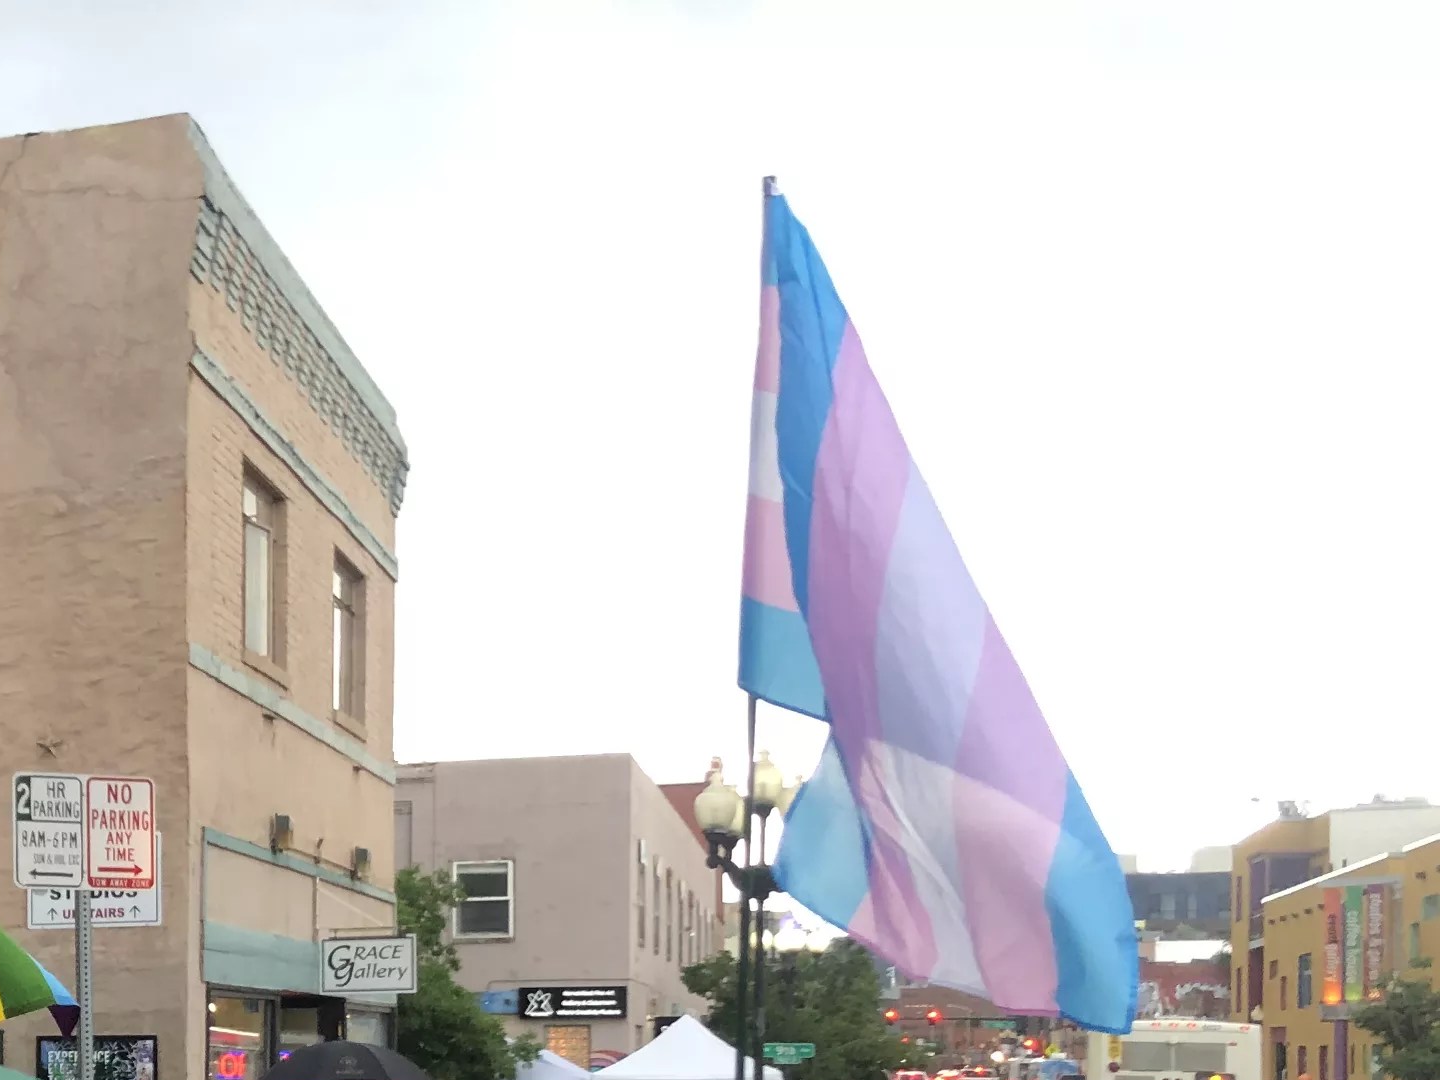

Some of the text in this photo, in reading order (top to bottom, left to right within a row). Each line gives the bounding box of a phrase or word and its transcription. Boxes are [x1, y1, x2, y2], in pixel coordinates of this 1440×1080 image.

[16, 781, 66, 815] 2 HR
[107, 783, 133, 805] NO
[32, 800, 80, 819] PARKING
[91, 808, 150, 831] PARKING
[106, 831, 133, 846] ANY
[104, 847, 136, 862] TIME
[92, 877, 150, 888] TOW AWAY ZONE
[62, 907, 126, 920] UTAIRS
[328, 944, 405, 970] GRACE
